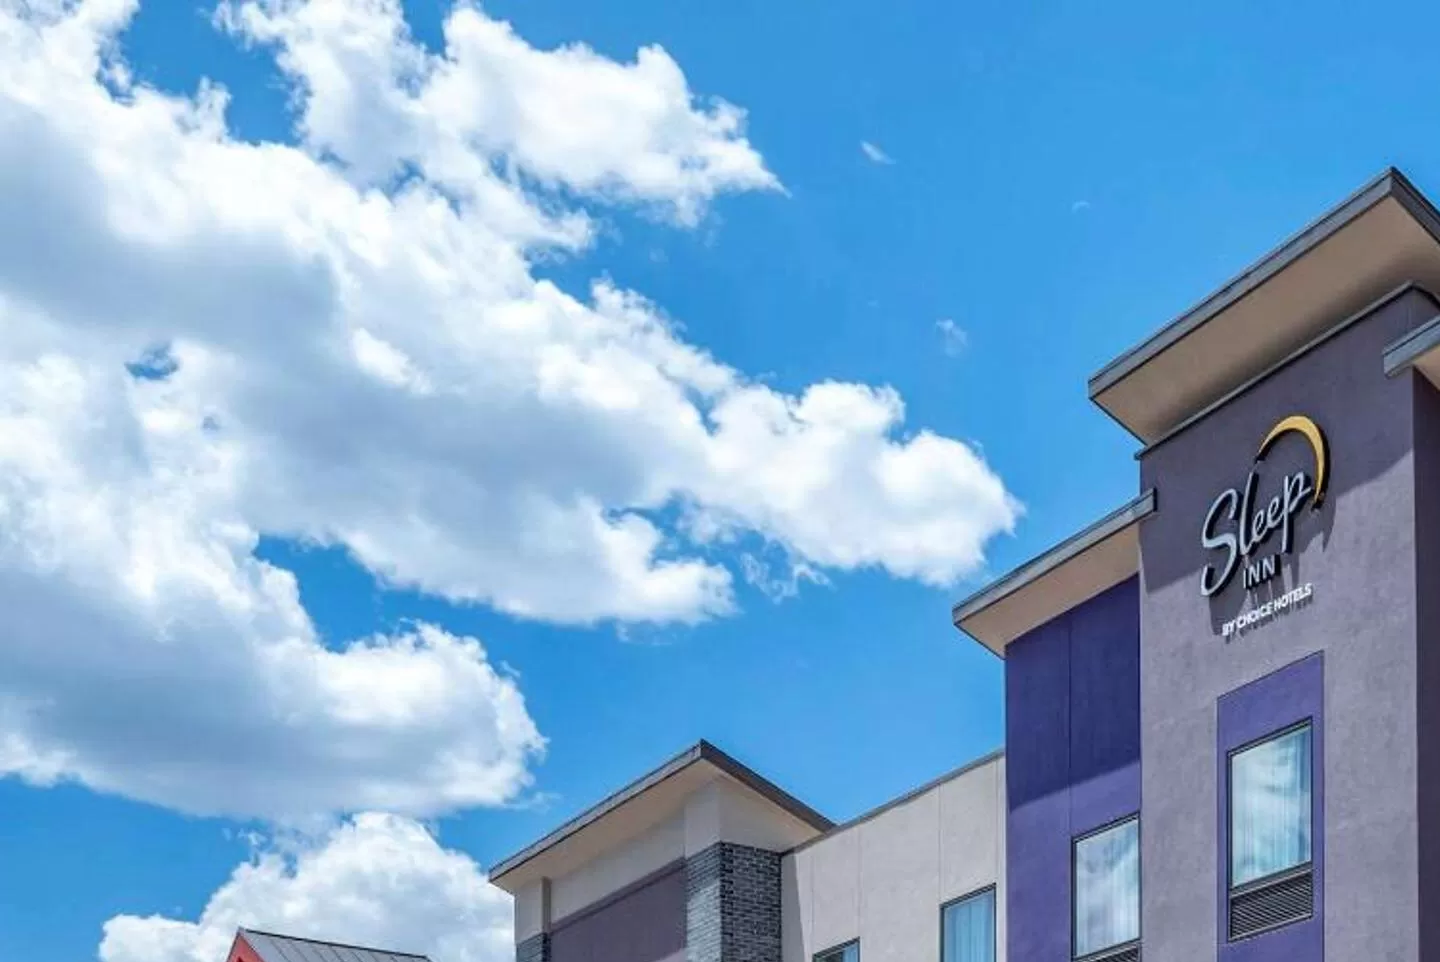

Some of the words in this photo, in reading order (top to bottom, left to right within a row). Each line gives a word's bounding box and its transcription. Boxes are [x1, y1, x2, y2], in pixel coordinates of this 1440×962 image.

[1201, 470, 1312, 597] Sleep
[1243, 554, 1277, 589] INN
[1222, 620, 1236, 636] BY
[1236, 602, 1273, 629] CHOICE
[1273, 582, 1313, 612] HOTELS
